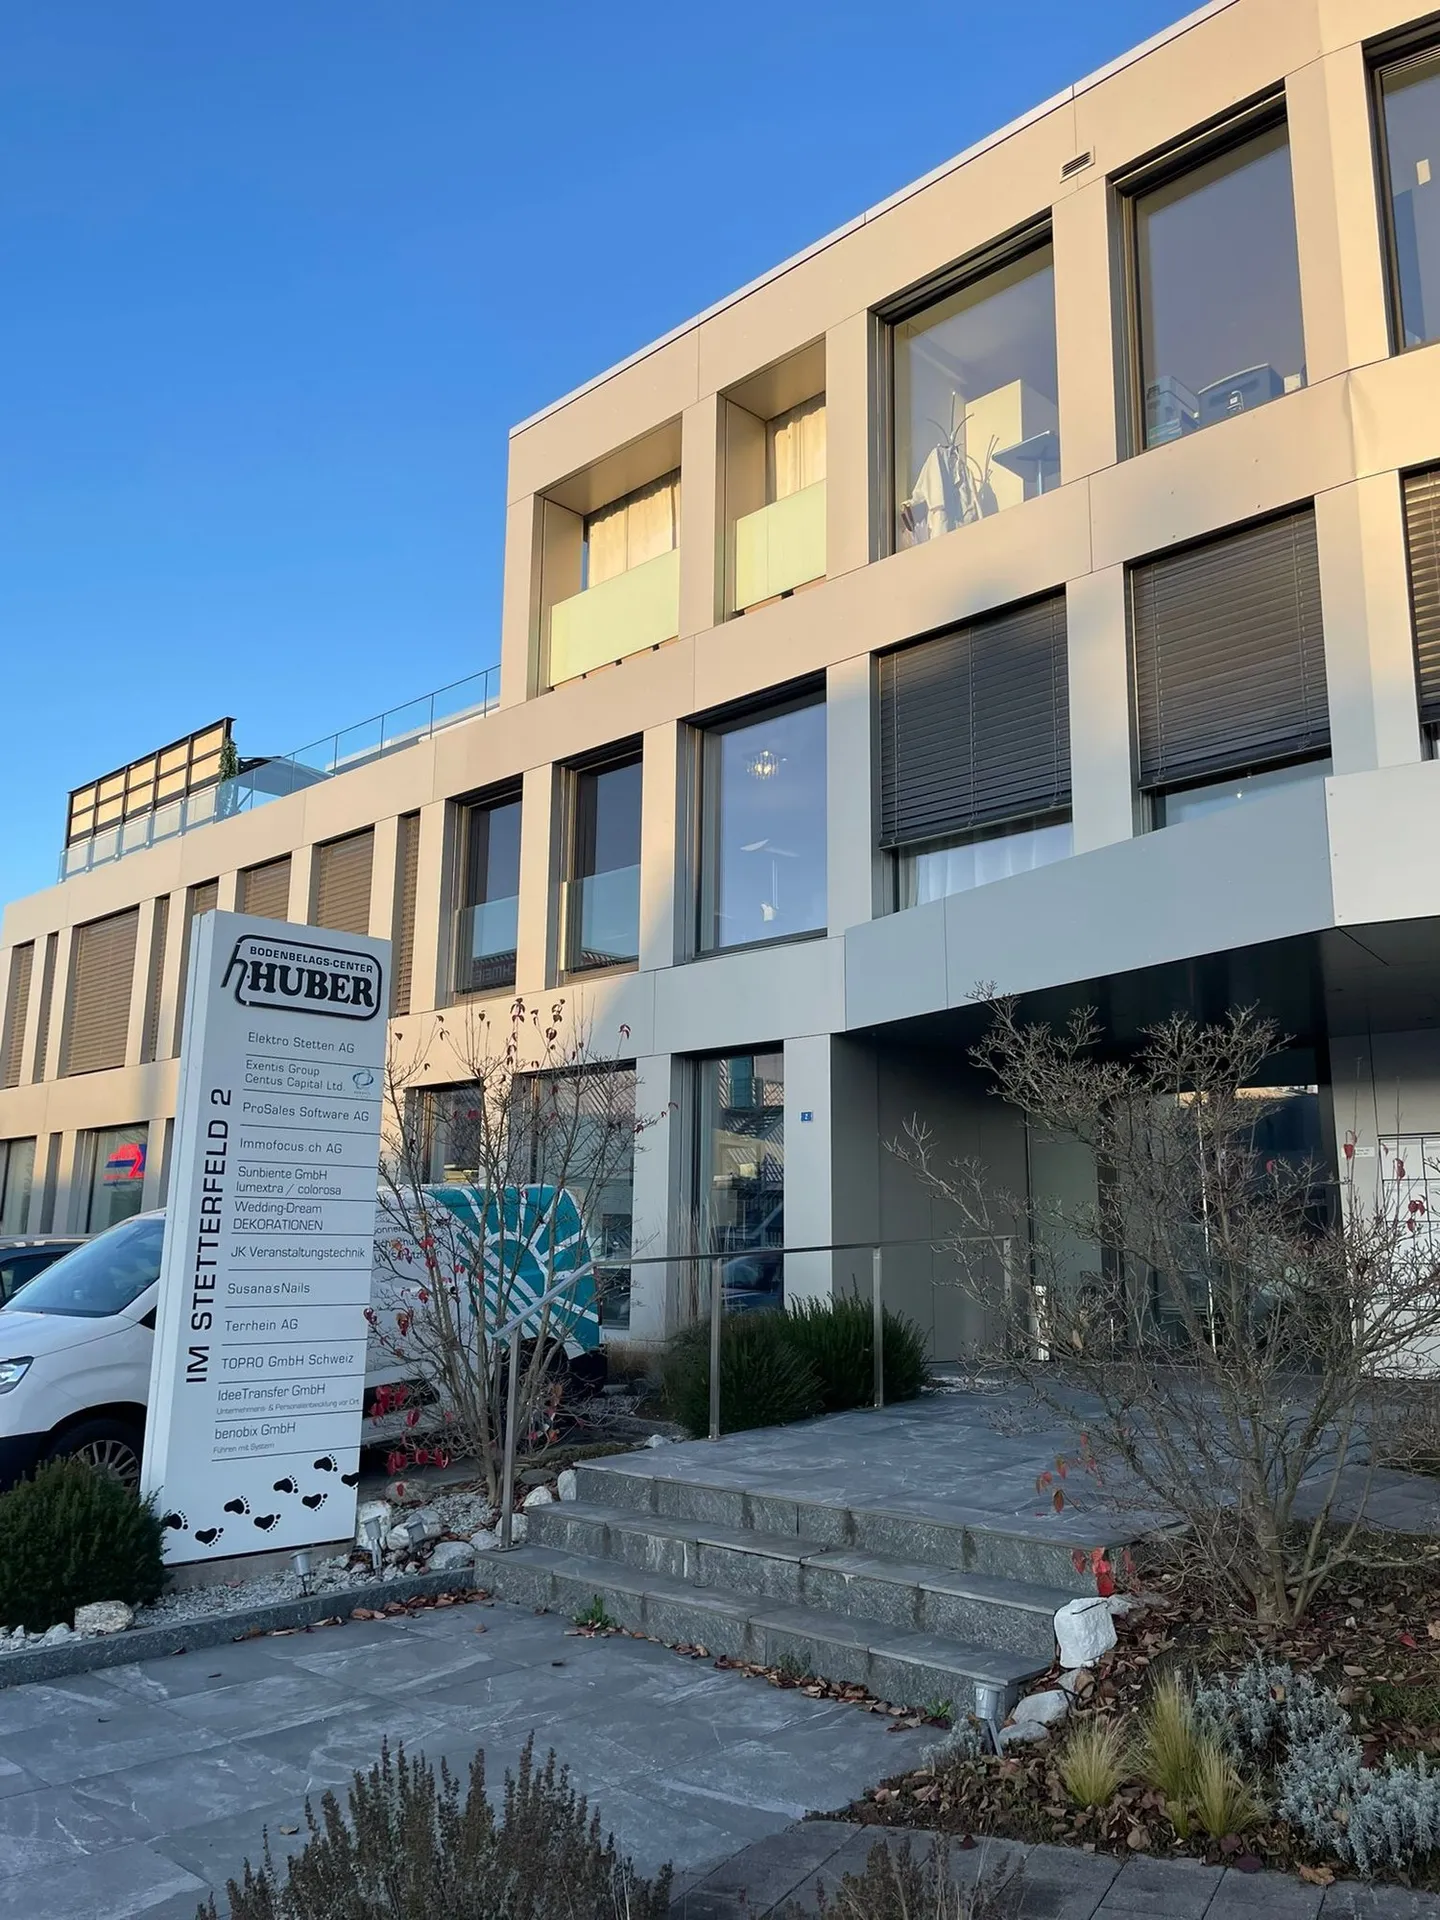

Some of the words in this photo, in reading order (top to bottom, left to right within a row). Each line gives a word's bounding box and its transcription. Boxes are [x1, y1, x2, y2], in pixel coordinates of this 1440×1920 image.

[250, 946, 373, 974] BODENBELAGS-CENTER
[248, 960, 374, 1008] HUBER
[248, 1032, 289, 1046] Elektro
[294, 1037, 334, 1050] Stetten
[339, 1043, 355, 1053] AG
[246, 1060, 284, 1073] Exentis
[288, 1064, 320, 1078] Group
[245, 1074, 282, 1086] Centus
[287, 1077, 322, 1092] Capital
[327, 1081, 346, 1092] Ltd.
[211, 1088, 231, 1106] 2
[242, 1102, 295, 1116] ProSales
[300, 1107, 349, 1120] Software
[354, 1111, 369, 1121] AG
[326, 1143, 342, 1154] AG
[238, 1166, 292, 1179] Sunbiente
[295, 1169, 328, 1180] GmbH
[236, 1182, 283, 1193] lumextra
[298, 1184, 341, 1195] colorosa
[234, 1201, 322, 1215] Wedding-Dream
[191, 1120, 228, 1330] STETTERFELD
[233, 1218, 323, 1230] DEKORATIONEN
[231, 1246, 246, 1258] JK
[250, 1246, 365, 1260] Veranstaltungstechnik
[225, 1320, 276, 1332] Terrhein
[281, 1319, 298, 1330] AG
[186, 1346, 210, 1383] IM
[221, 1356, 264, 1369] TOPRO
[268, 1356, 304, 1367] GmbH
[308, 1354, 354, 1365] Schweiz
[218, 1387, 289, 1401] IdeeTransfer
[292, 1384, 326, 1396] GmbH
[215, 1426, 258, 1440] benobix
[261, 1422, 296, 1436] GmbH
[251, 1442, 275, 1451] System
